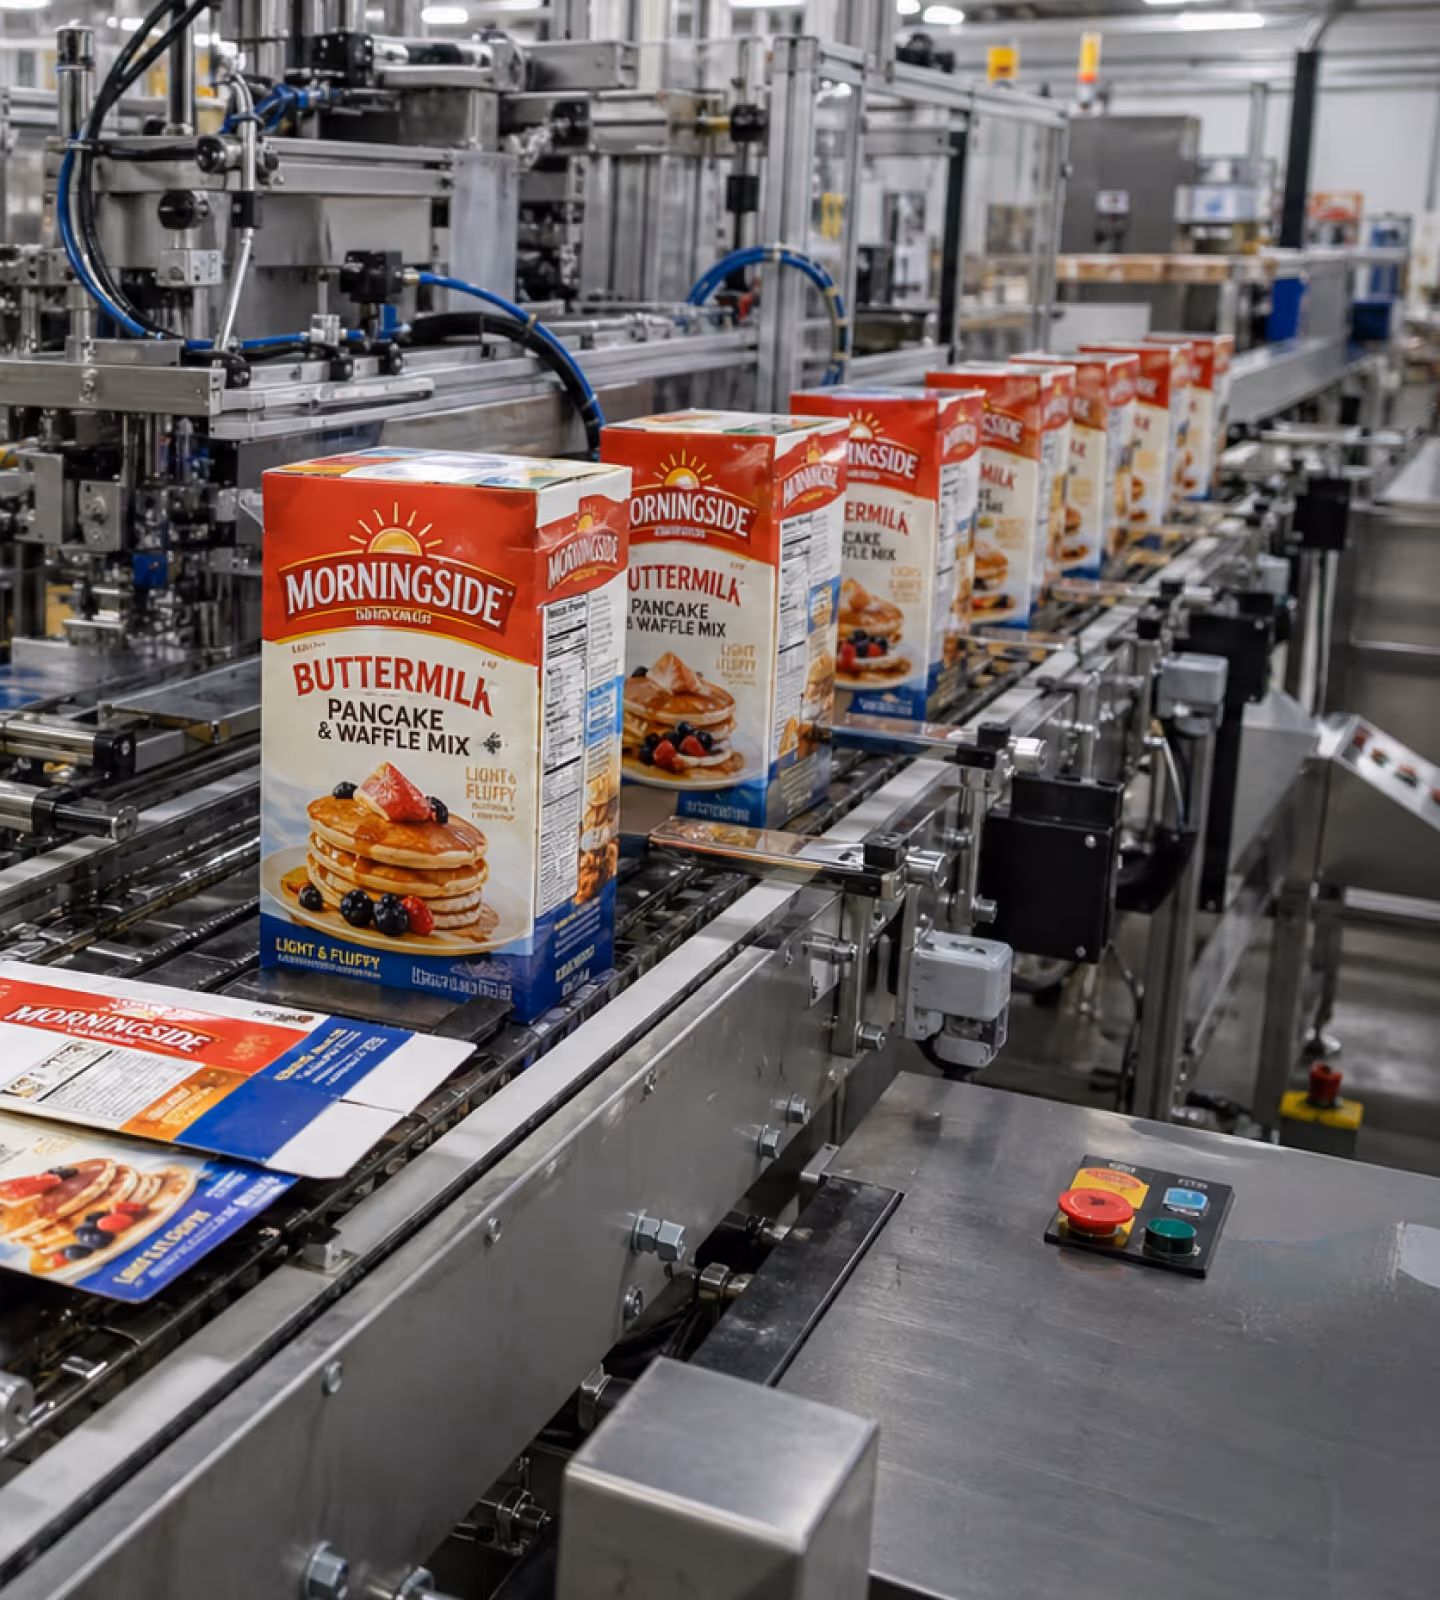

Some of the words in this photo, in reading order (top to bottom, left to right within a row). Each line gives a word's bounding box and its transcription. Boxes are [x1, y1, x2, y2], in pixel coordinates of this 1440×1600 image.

[846, 441, 918, 480] INGSIDE
[630, 492, 750, 537] ORNINGSIDE
[844, 501, 909, 536] ERMILK
[285, 562, 502, 628] MORNINGSIDE
[628, 564, 741, 607] UTTERMILK
[631, 598, 709, 619] PANCAKE
[637, 616, 695, 636] WAFFLE
[698, 622, 726, 638] MIX
[293, 655, 494, 719] BUTTERMILK
[328, 698, 444, 732] PANCAKE
[318, 721, 333, 741] &
[336, 722, 421, 752] WAFFLE
[427, 733, 471, 757] MIX
[275, 937, 315, 958] LIGHT
[4, 1004, 212, 1053] MORNINGSIDE
